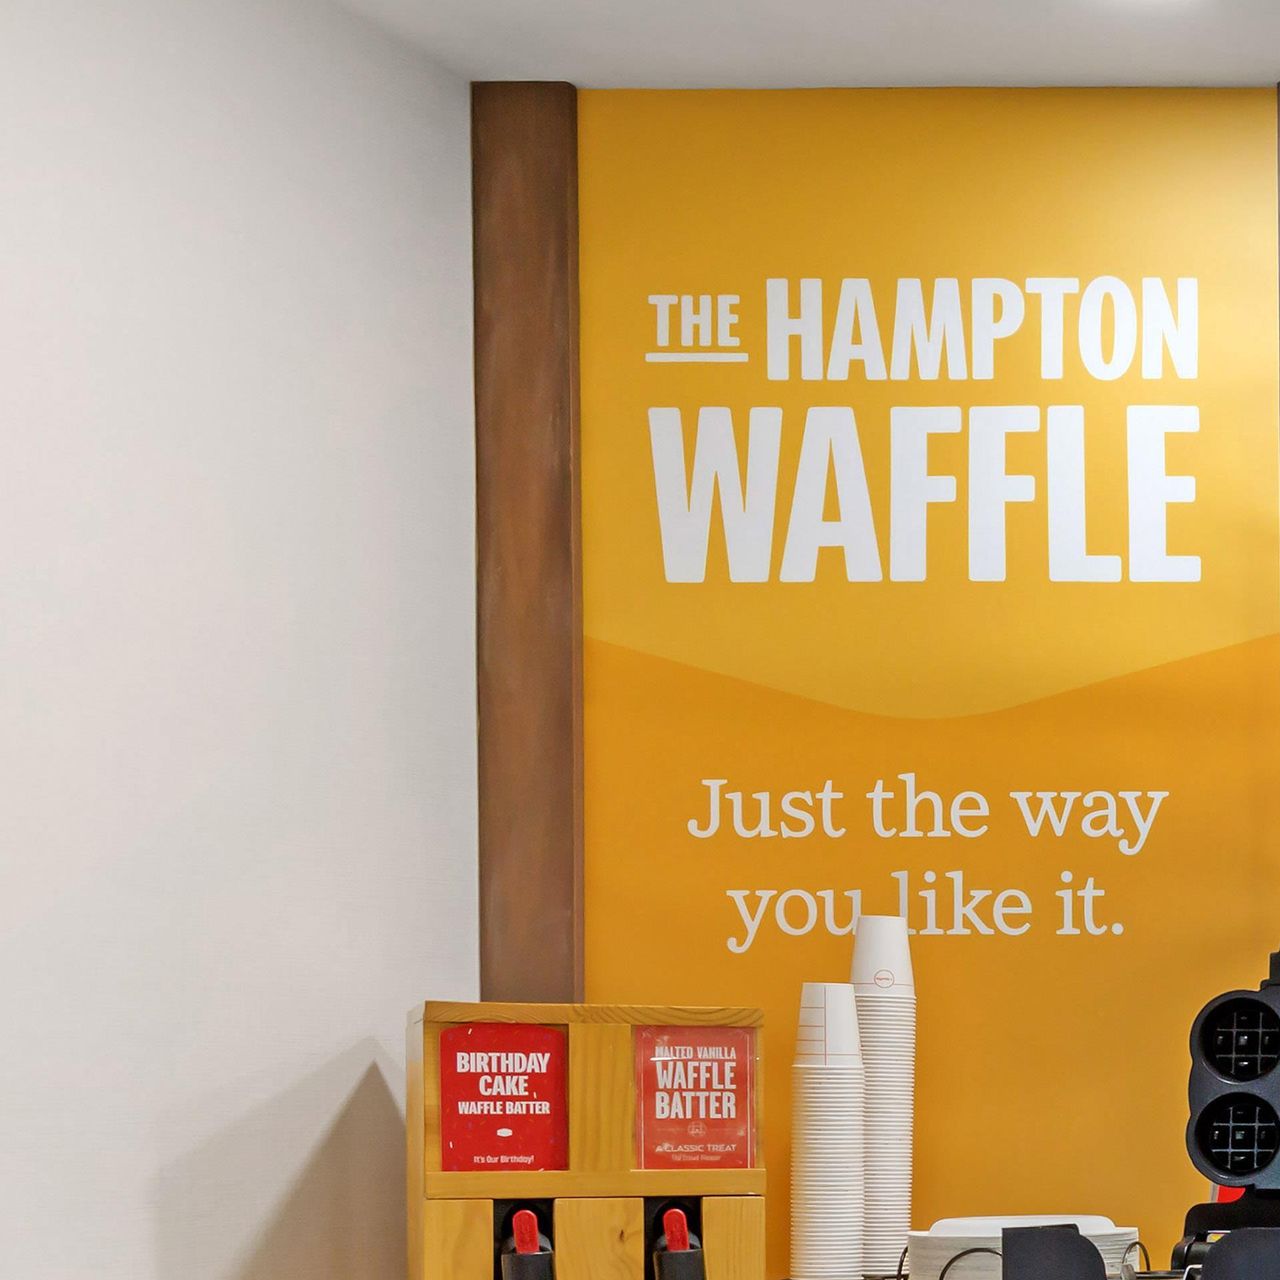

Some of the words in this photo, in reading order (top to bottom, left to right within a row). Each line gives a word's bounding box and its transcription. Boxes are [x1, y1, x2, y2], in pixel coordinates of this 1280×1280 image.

[647, 294, 740, 347] THE
[766, 275, 1199, 381] HAMPTON
[647, 405, 1202, 583] WAFFLE
[687, 778, 846, 839] Just
[865, 773, 989, 839] the
[1009, 790, 1169, 856] way
[726, 889, 863, 954] you
[891, 871, 1033, 937] like
[1055, 871, 1124, 937] it.
[456, 1052, 550, 1073] BIRTHDAY
[655, 1046, 693, 1060] MALTED
[697, 1046, 737, 1060] VANILLA
[479, 1075, 529, 1096] CAKE
[655, 1061, 737, 1090] WAFFLE
[458, 1101, 503, 1115] WAFFLE
[505, 1101, 551, 1115] BATTER
[655, 1091, 737, 1119] BATTER
[664, 1144, 705, 1153] CLASSIC
[707, 1144, 737, 1153] TREAT
